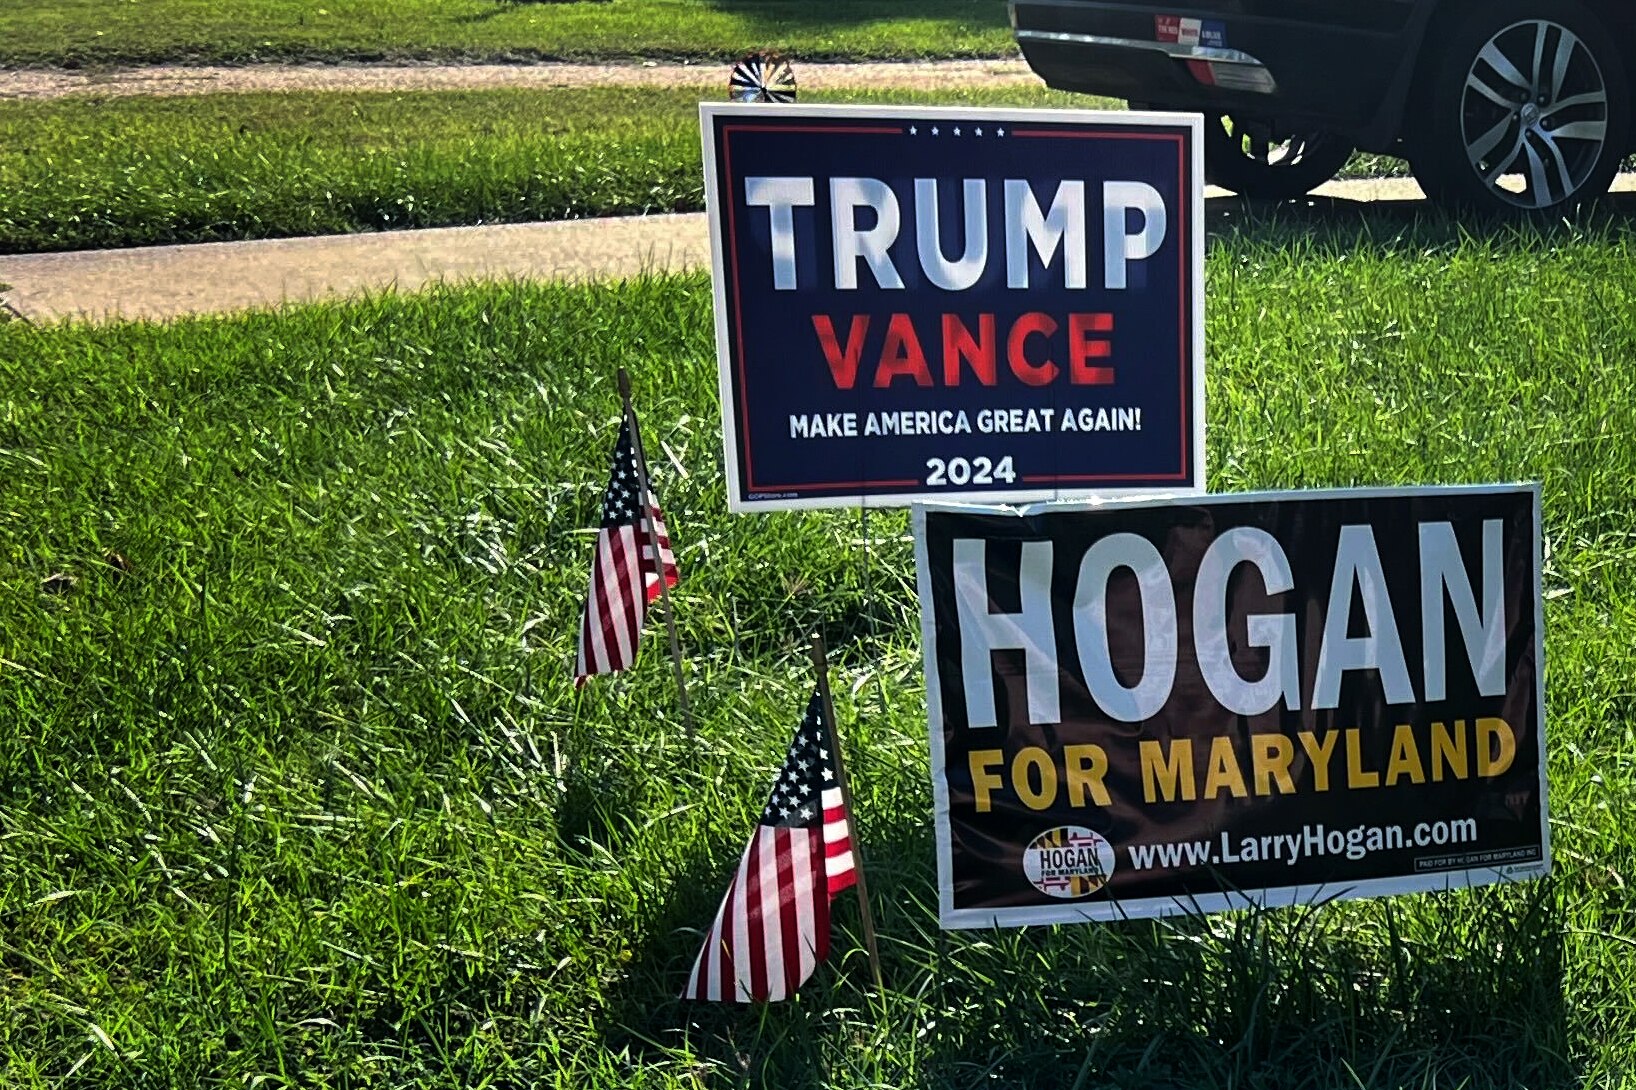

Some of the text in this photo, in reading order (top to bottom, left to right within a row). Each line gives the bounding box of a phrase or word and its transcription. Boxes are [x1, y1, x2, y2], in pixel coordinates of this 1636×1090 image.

[744, 176, 1167, 291] TRUMP
[811, 312, 1115, 390] VANCE
[789, 407, 1142, 438] MAKE AMERICA GREAT AGAIN!
[926, 456, 1017, 486] 2024
[951, 518, 1507, 729] HOGAN
[967, 717, 1517, 813] FOR MARYLAND
[1040, 847, 1099, 869] HOGAN
[1128, 813, 1478, 872] www.LarryHogan.com
